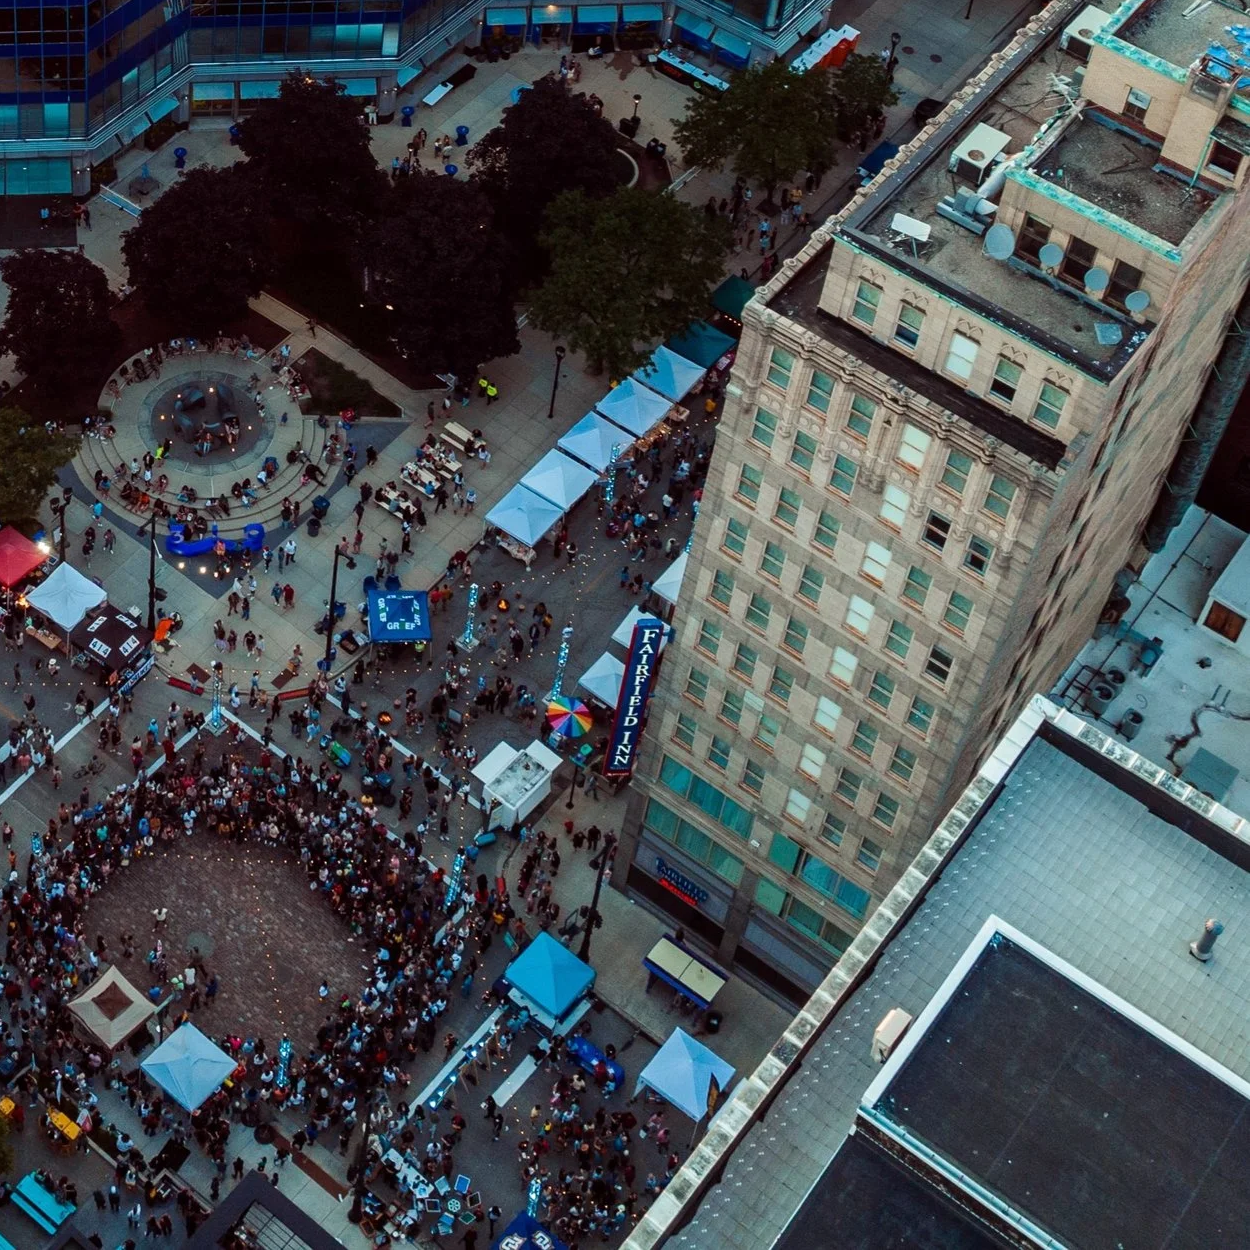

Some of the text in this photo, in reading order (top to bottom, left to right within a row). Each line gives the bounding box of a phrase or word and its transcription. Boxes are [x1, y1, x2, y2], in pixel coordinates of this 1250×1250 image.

[91, 640, 109, 657] 414
[122, 637, 138, 654] 414
[623, 629, 660, 727] FAIRFIELD
[614, 731, 633, 765] INN
